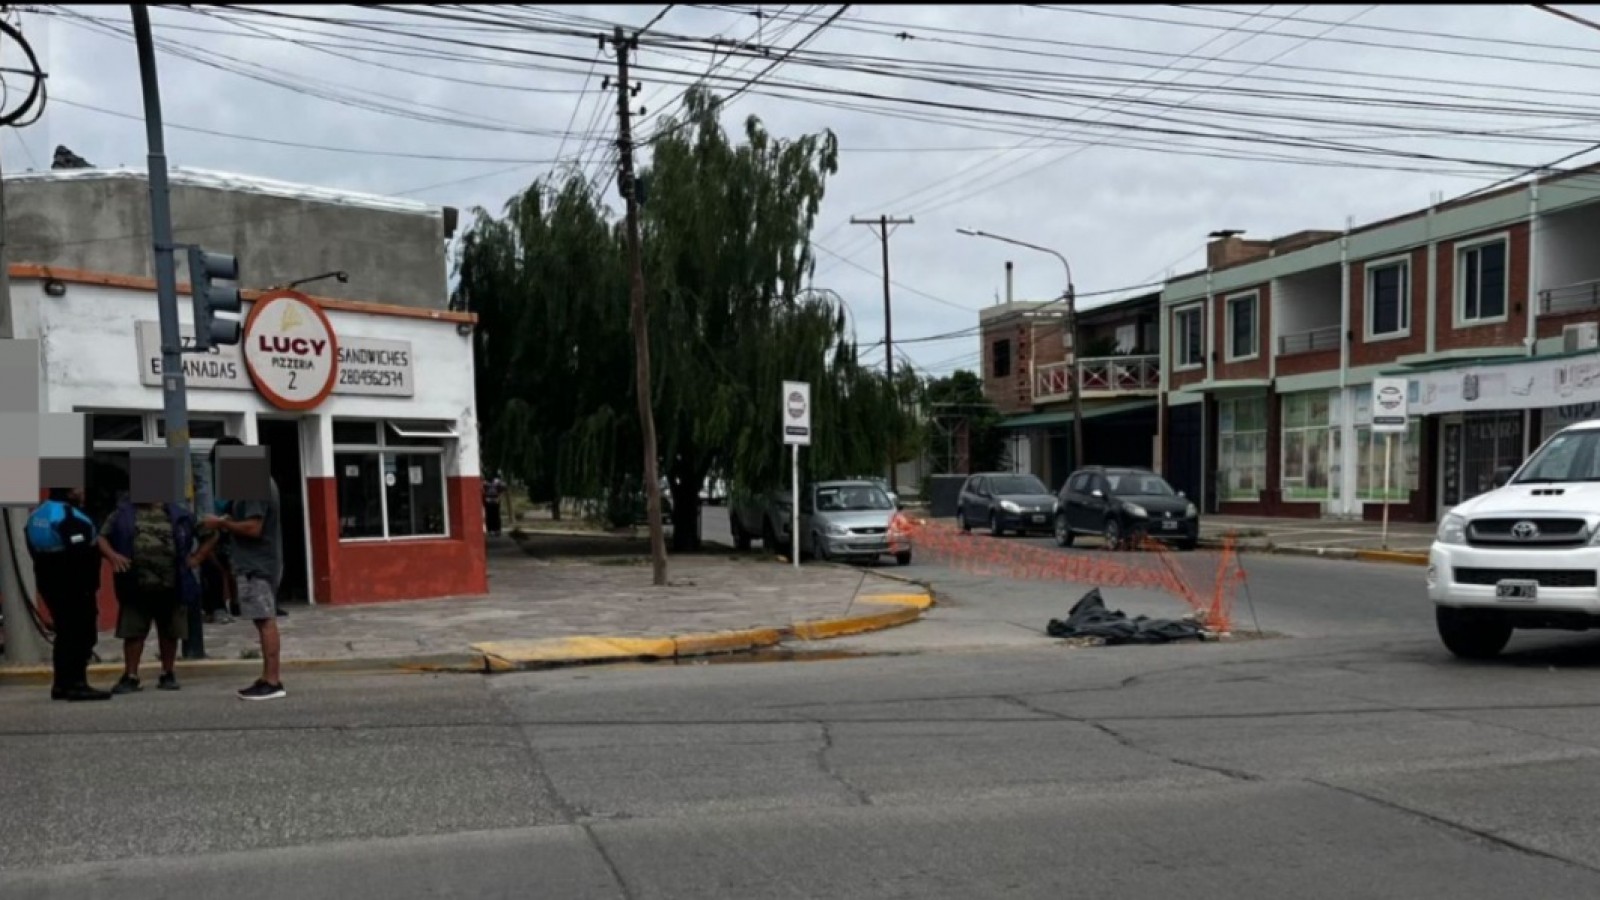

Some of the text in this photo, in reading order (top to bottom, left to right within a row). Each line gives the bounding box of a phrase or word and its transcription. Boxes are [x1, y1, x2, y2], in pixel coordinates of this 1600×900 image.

[259, 335, 326, 356] LUCY
[271, 356, 315, 371] PIZZERIA
[337, 347, 408, 367] SANDWICHES
[151, 357, 237, 380] EANADAS
[288, 371, 298, 390] 2
